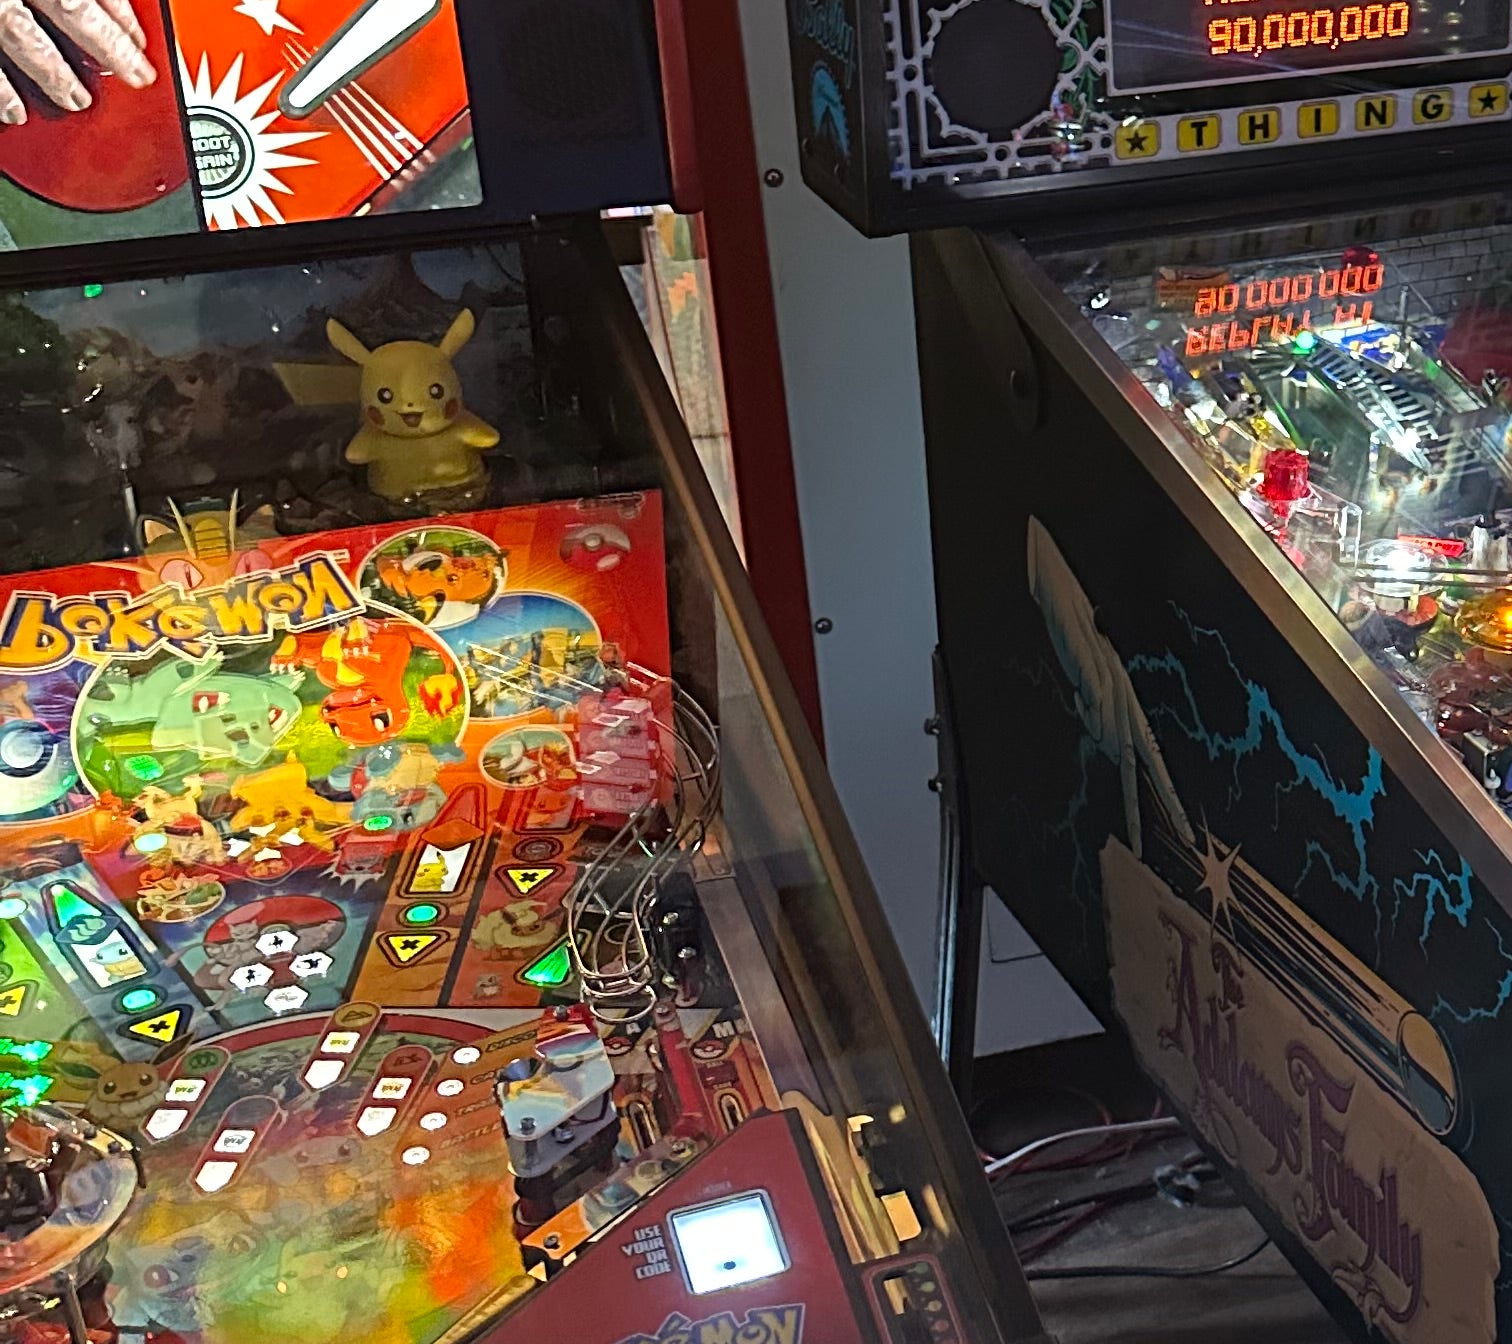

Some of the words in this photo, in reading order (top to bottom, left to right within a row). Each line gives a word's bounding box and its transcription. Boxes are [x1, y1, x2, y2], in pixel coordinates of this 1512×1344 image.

[1207, 1, 1410, 58] 90,000,000
[1158, 911, 1301, 1176] Addams
[1286, 1039, 1421, 1324] Family
[634, 1225, 661, 1241] USE
[621, 1237, 664, 1256] YOUR
[635, 1260, 672, 1280] CODE
